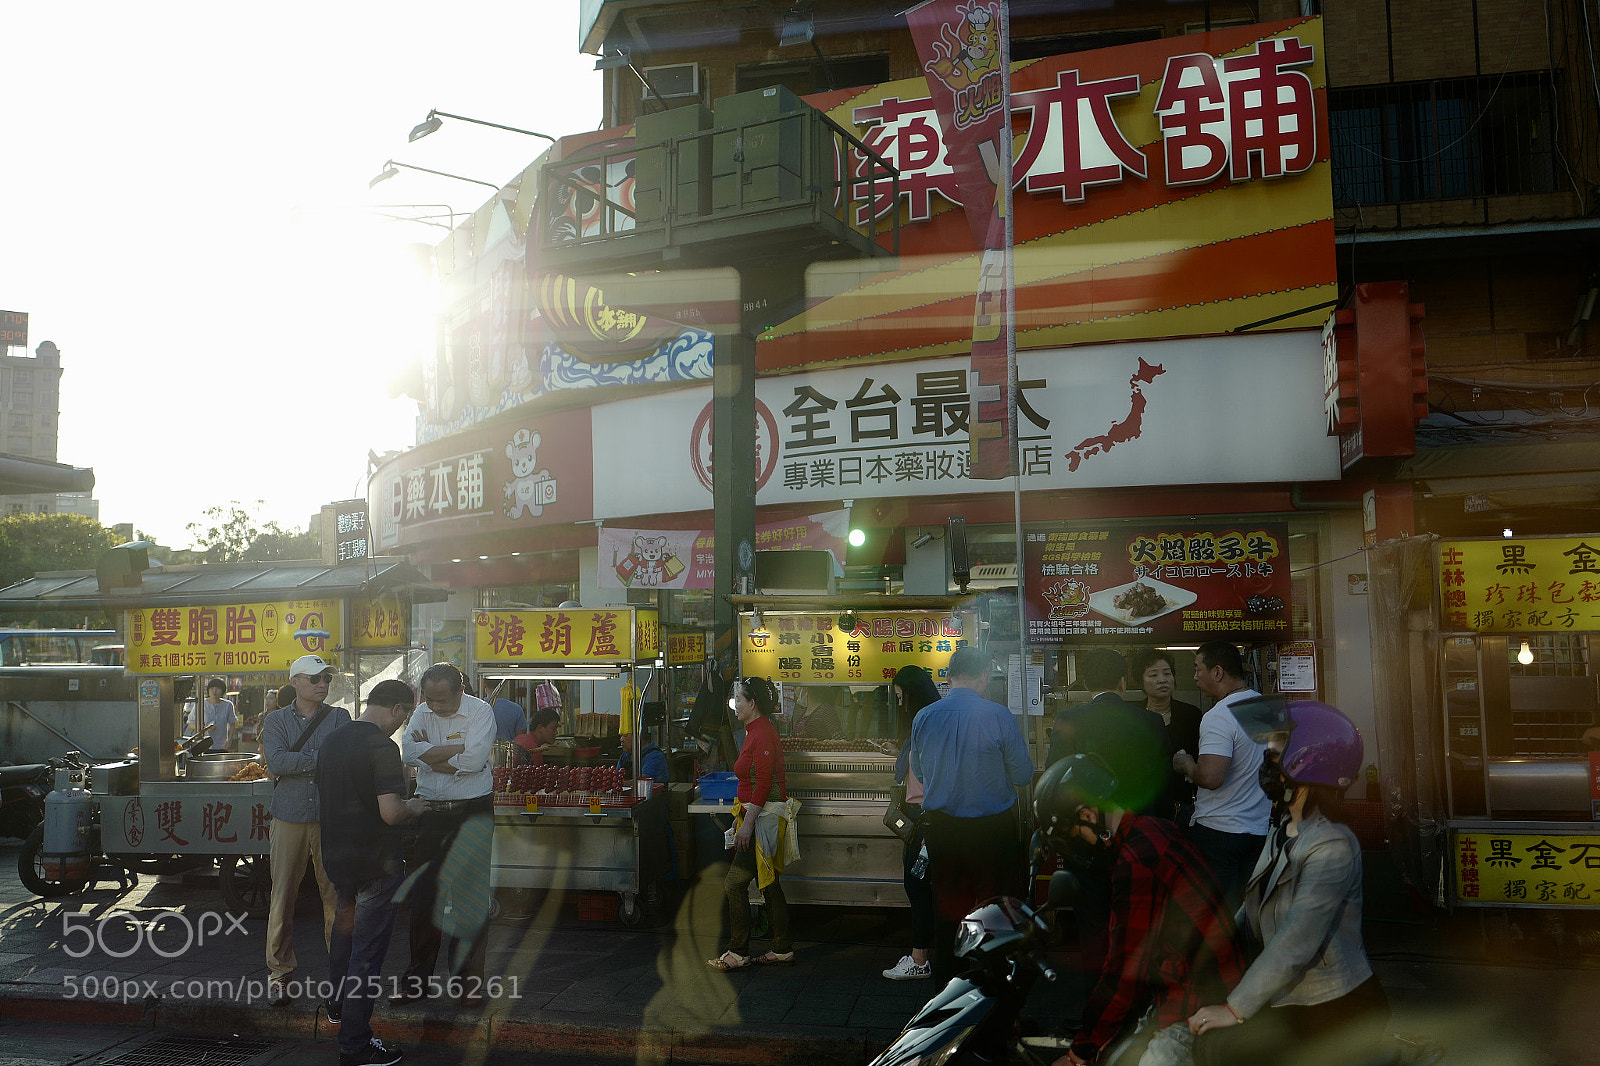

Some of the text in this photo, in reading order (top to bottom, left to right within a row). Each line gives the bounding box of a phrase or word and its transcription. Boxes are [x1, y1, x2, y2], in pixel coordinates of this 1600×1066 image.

[834, 37, 1317, 227] 藥本舖
[782, 445, 1052, 491] 專業日本藥妝店
[392, 453, 484, 524] 日藥本舖
[1041, 563, 1100, 577] 檢驗合格
[1442, 547, 1467, 628] 士林總店
[150, 606, 257, 647] 雙胞胎
[1473, 607, 1600, 629] 獨家配方
[488, 612, 621, 657] 糖葫蘆
[139, 652, 206, 668] 素食1個15元
[213, 650, 270, 666] 7個100元
[847, 640, 861, 667] 每份
[780, 671, 801, 679] 30
[813, 671, 834, 679] 30
[848, 669, 862, 678] 55
[527, 797, 537, 805] 30
[1460, 838, 1480, 898] 士林總店
[1503, 879, 1600, 901] 獨家配
